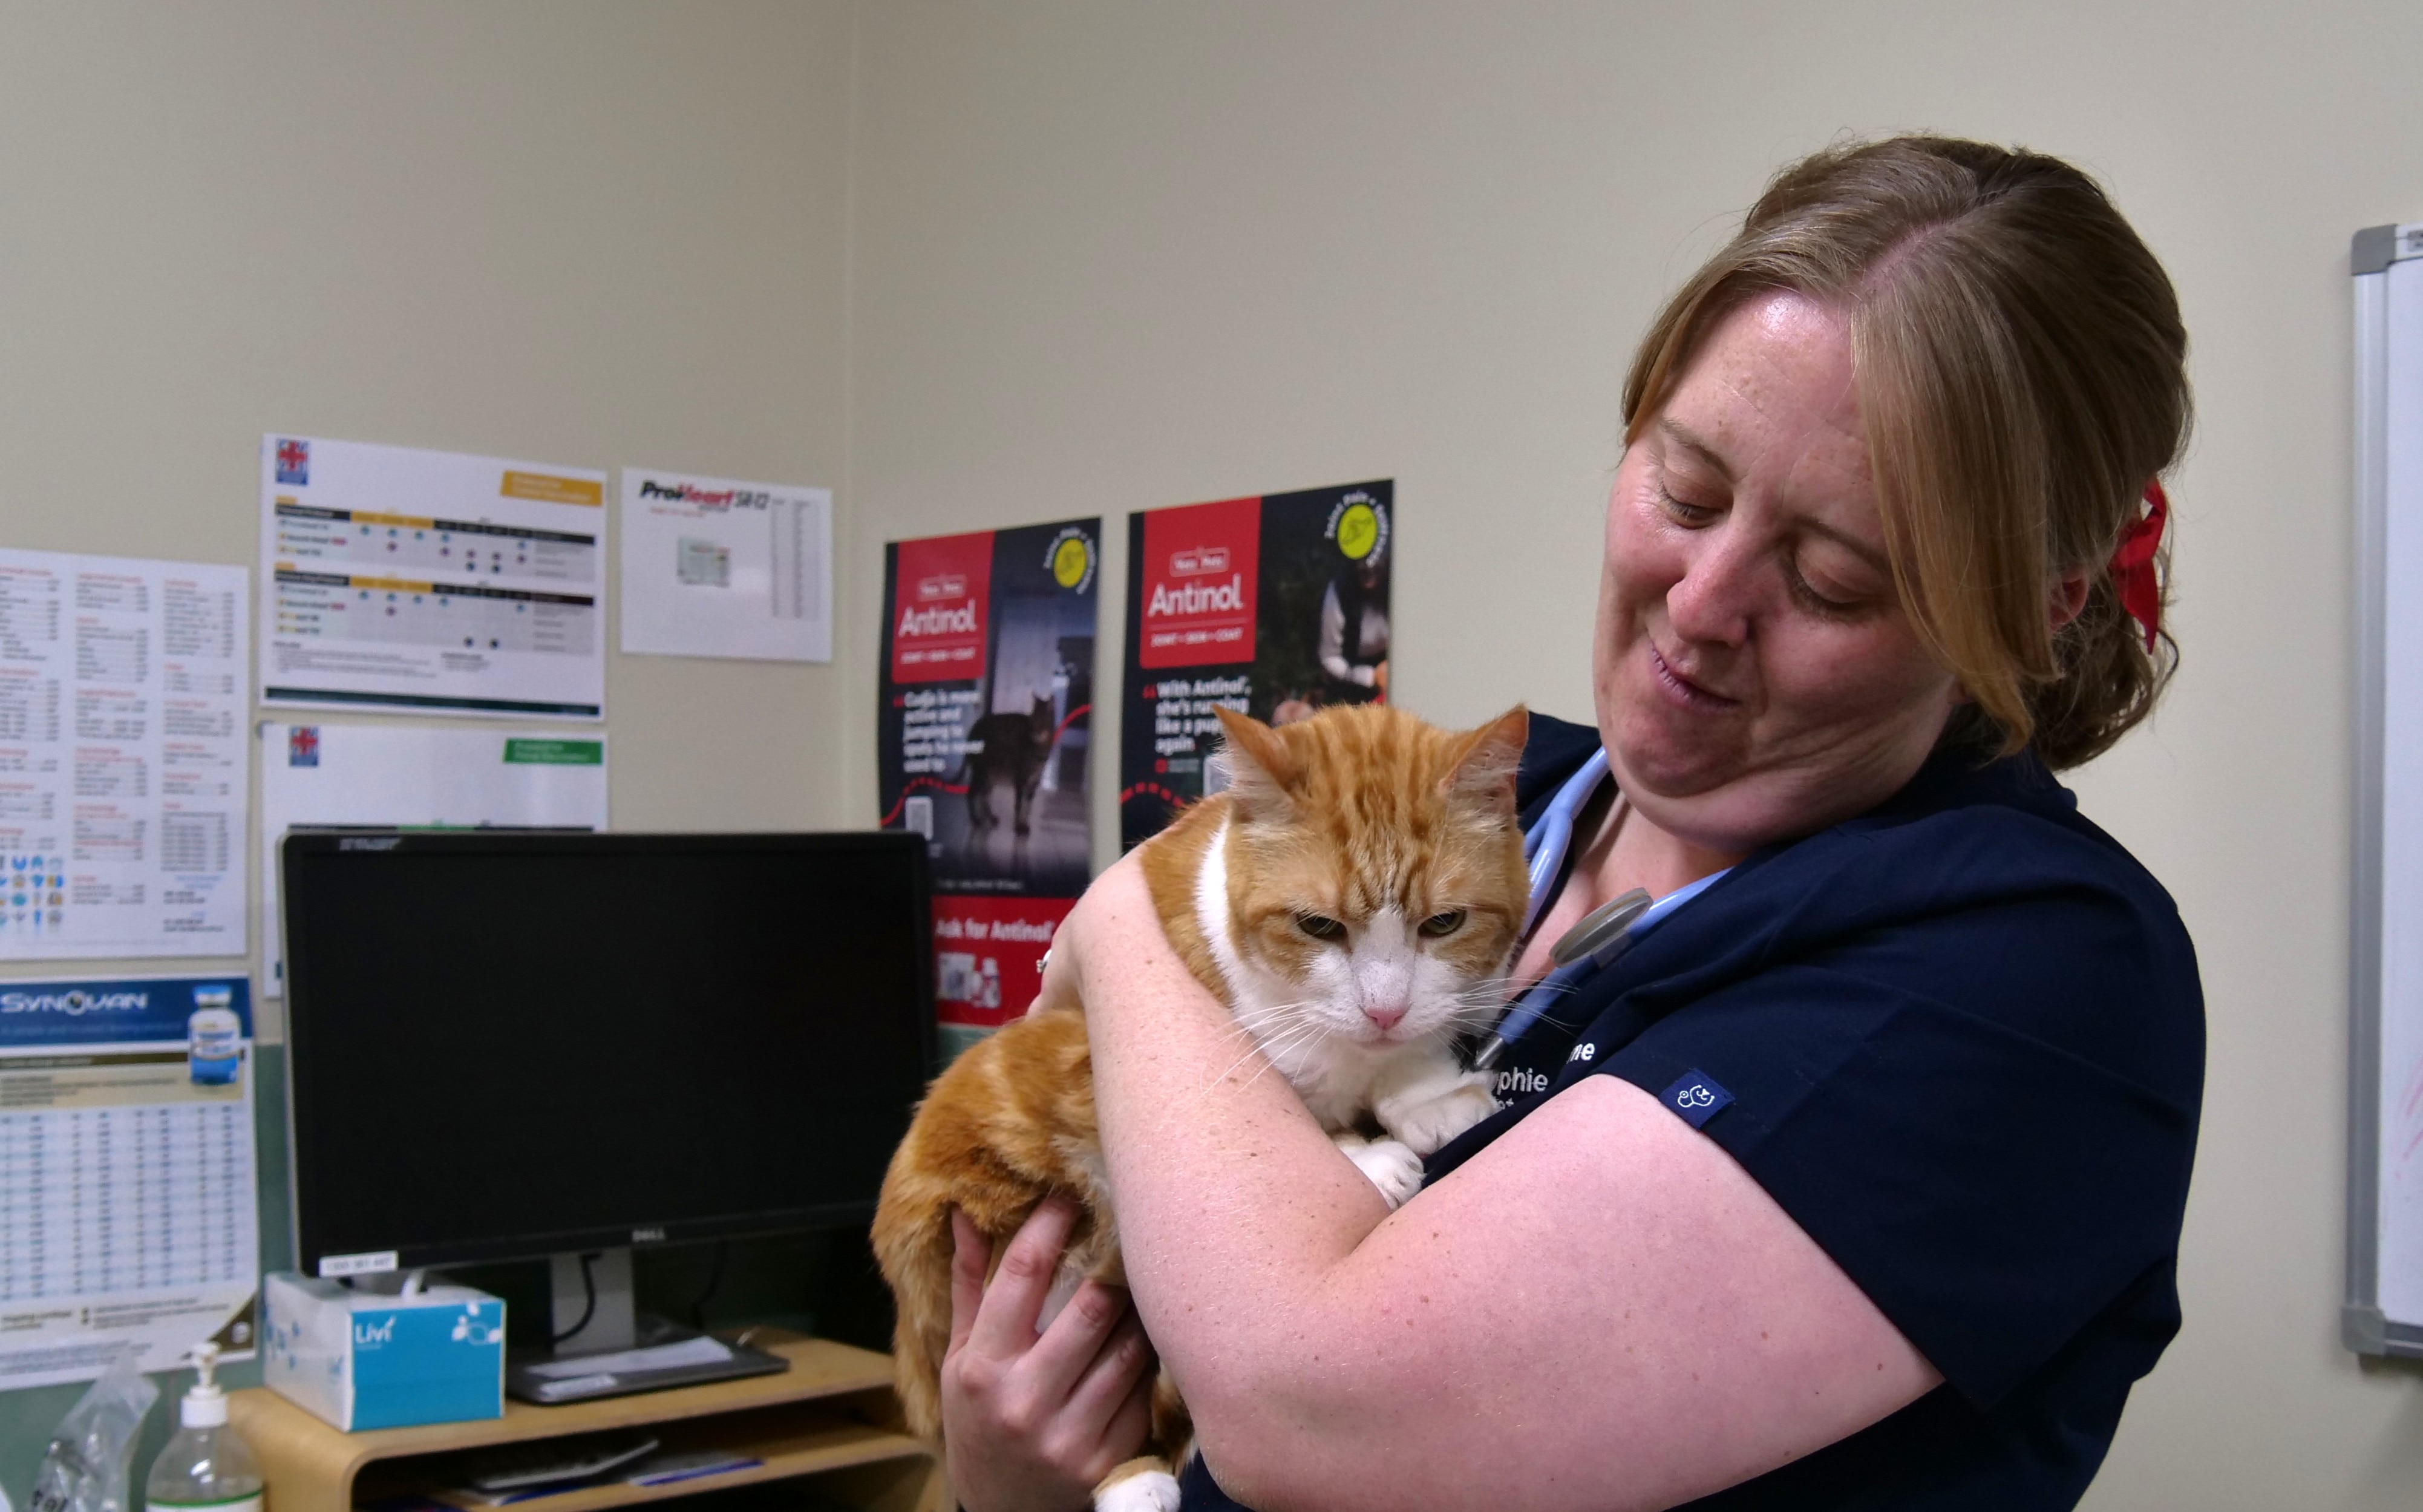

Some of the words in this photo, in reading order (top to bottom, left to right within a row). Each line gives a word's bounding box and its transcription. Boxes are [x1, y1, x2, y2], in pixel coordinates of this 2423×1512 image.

[639, 479, 734, 506] ProHeart
[1147, 572, 1244, 618] Antinol
[898, 598, 978, 638] Antinol
[1156, 679, 1191, 698] With
[1155, 716, 1181, 735] like
[937, 917, 963, 938] Ask
[964, 917, 989, 940] for
[1497, 1066, 1549, 1096] phie
